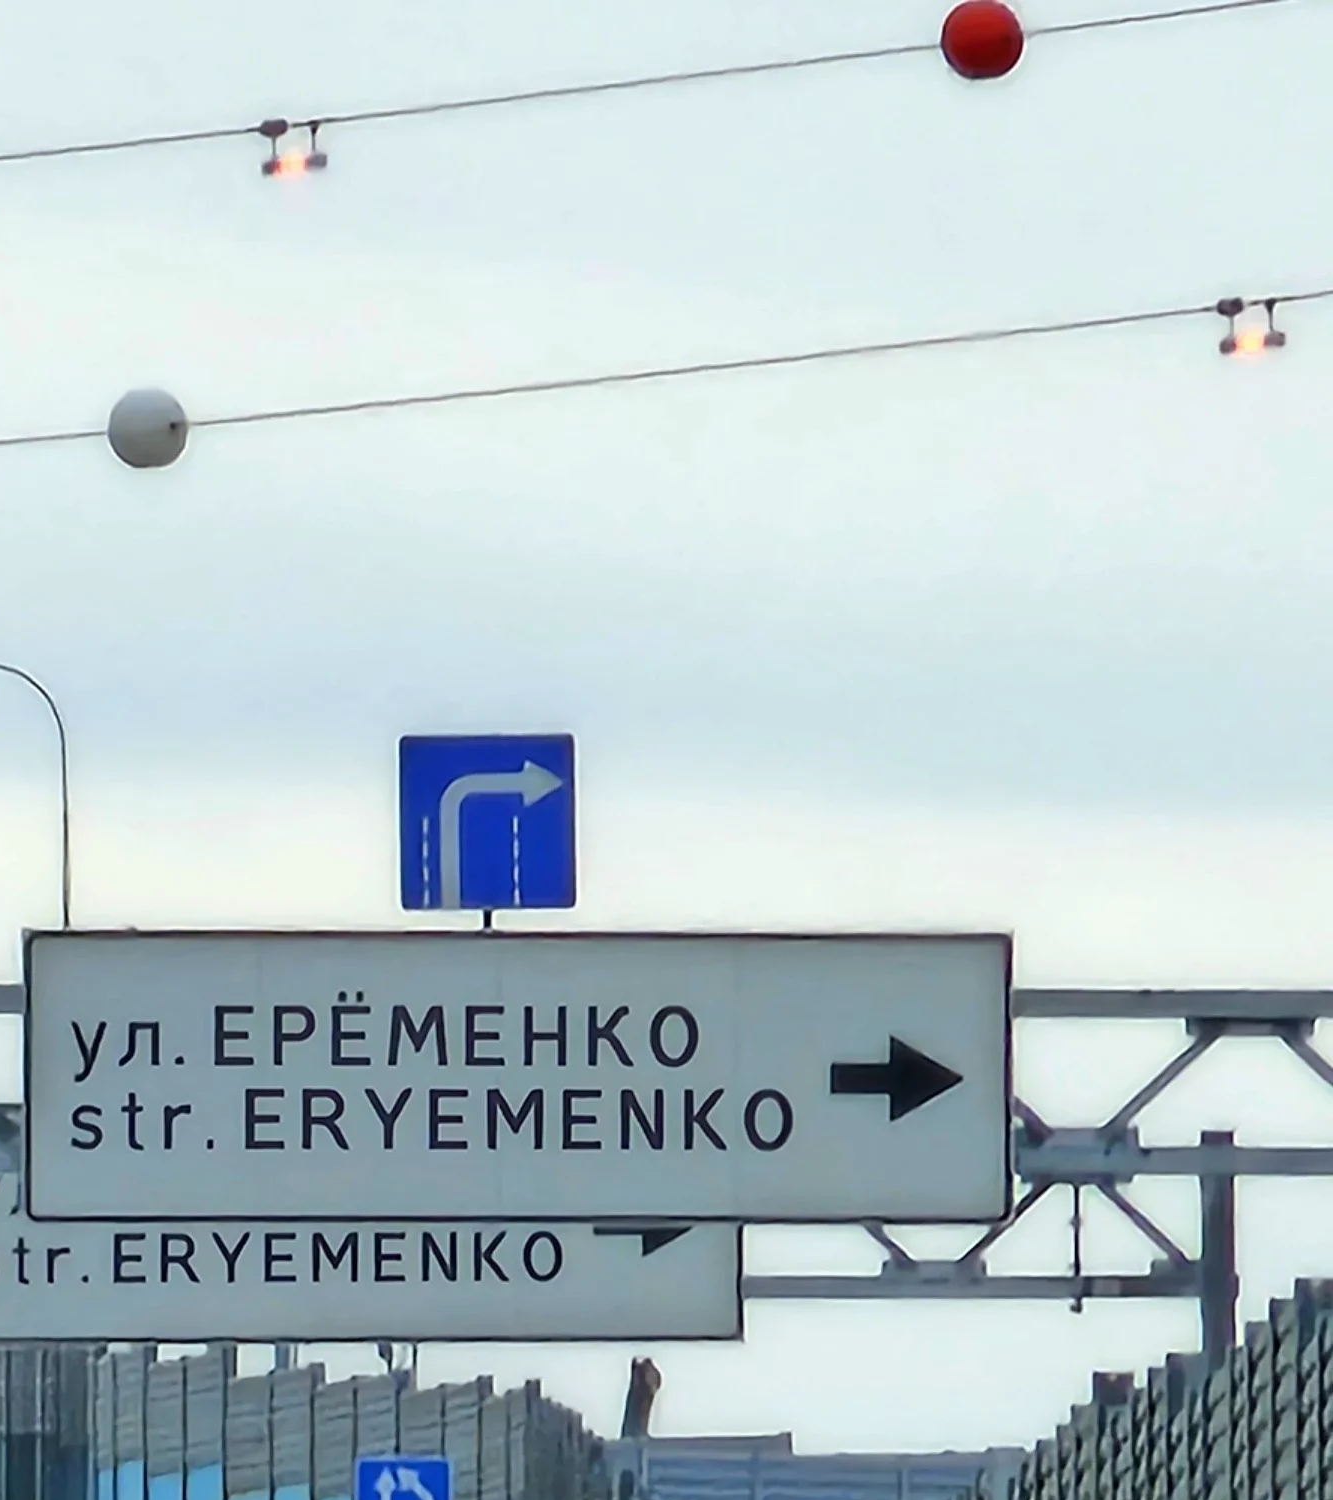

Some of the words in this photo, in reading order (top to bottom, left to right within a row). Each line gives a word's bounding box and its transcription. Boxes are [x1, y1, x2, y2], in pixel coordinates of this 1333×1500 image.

[71, 1020, 185, 1083] ул.
[213, 990, 700, 1068] ЕРЁМЕНКО
[71, 1092, 215, 1151] str.
[244, 1087, 795, 1152] ERYEMENKO
[113, 1230, 564, 1285] ERYEMENKO
